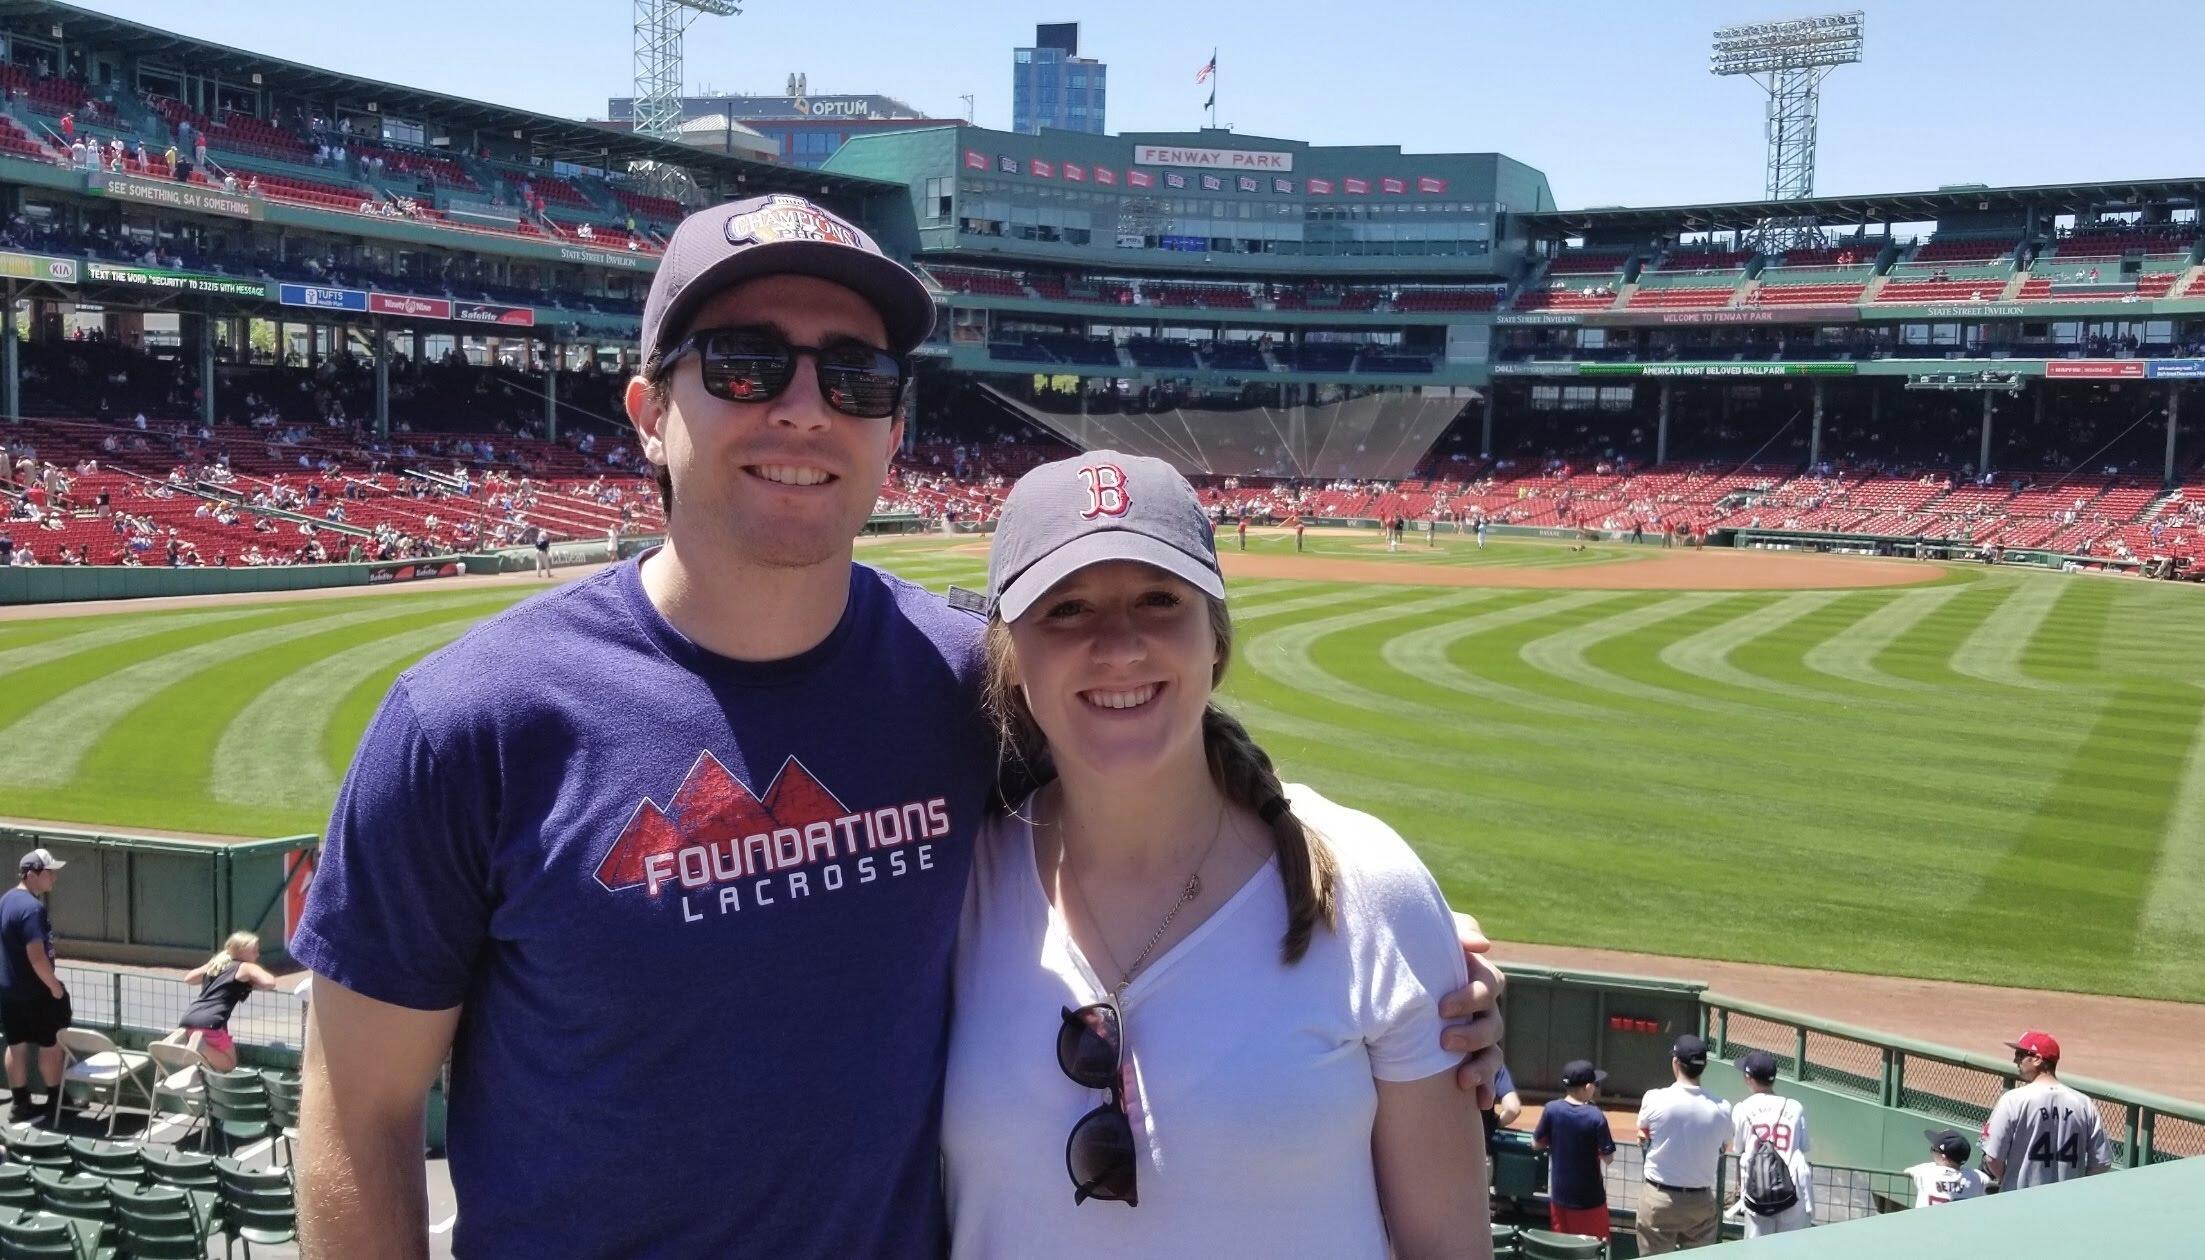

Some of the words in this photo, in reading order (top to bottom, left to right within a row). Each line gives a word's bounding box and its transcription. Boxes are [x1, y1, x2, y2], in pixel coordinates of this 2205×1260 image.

[813, 101, 868, 115] OPTUM
[1145, 149, 1221, 164] FENWAY
[1232, 154, 1282, 167] PARK
[108, 181, 127, 194] SEE
[184, 194, 202, 206] SAY
[203, 198, 249, 214] SOMETHING
[732, 210, 858, 247] CHAMPIONS
[52, 264, 70, 275] KIA
[90, 269, 110, 280] TEXT
[112, 271, 127, 282] THE
[127, 273, 148, 284] WORD
[189, 280, 198, 289] TO
[219, 283, 236, 293] WITH
[236, 284, 265, 297] MESSAGE
[317, 289, 344, 301] TUFTS
[460, 309, 497, 321] Safelite
[1663, 314, 1700, 323] WELCOME
[1702, 313, 1712, 322] TO
[1714, 313, 1748, 322] FENWAY
[1750, 312, 1772, 321] PARK
[1928, 307, 1952, 316] STATE
[1952, 306, 1980, 316] STREET
[1984, 306, 2025, 315] PAVILION
[1642, 366, 1682, 375] AMERICA'S
[1684, 367, 1705, 375] MOST
[1706, 367, 1741, 375] BELOVED
[1743, 366, 1785, 375] BALLPARK
[1077, 463, 1132, 521] B
[644, 798, 950, 896] FOUNDATIONS
[682, 844, 934, 923] LACROSSE
[2039, 1105, 2074, 1121] BAY
[1751, 1123, 1792, 1152] 28
[2028, 1131, 2079, 1169] 44
